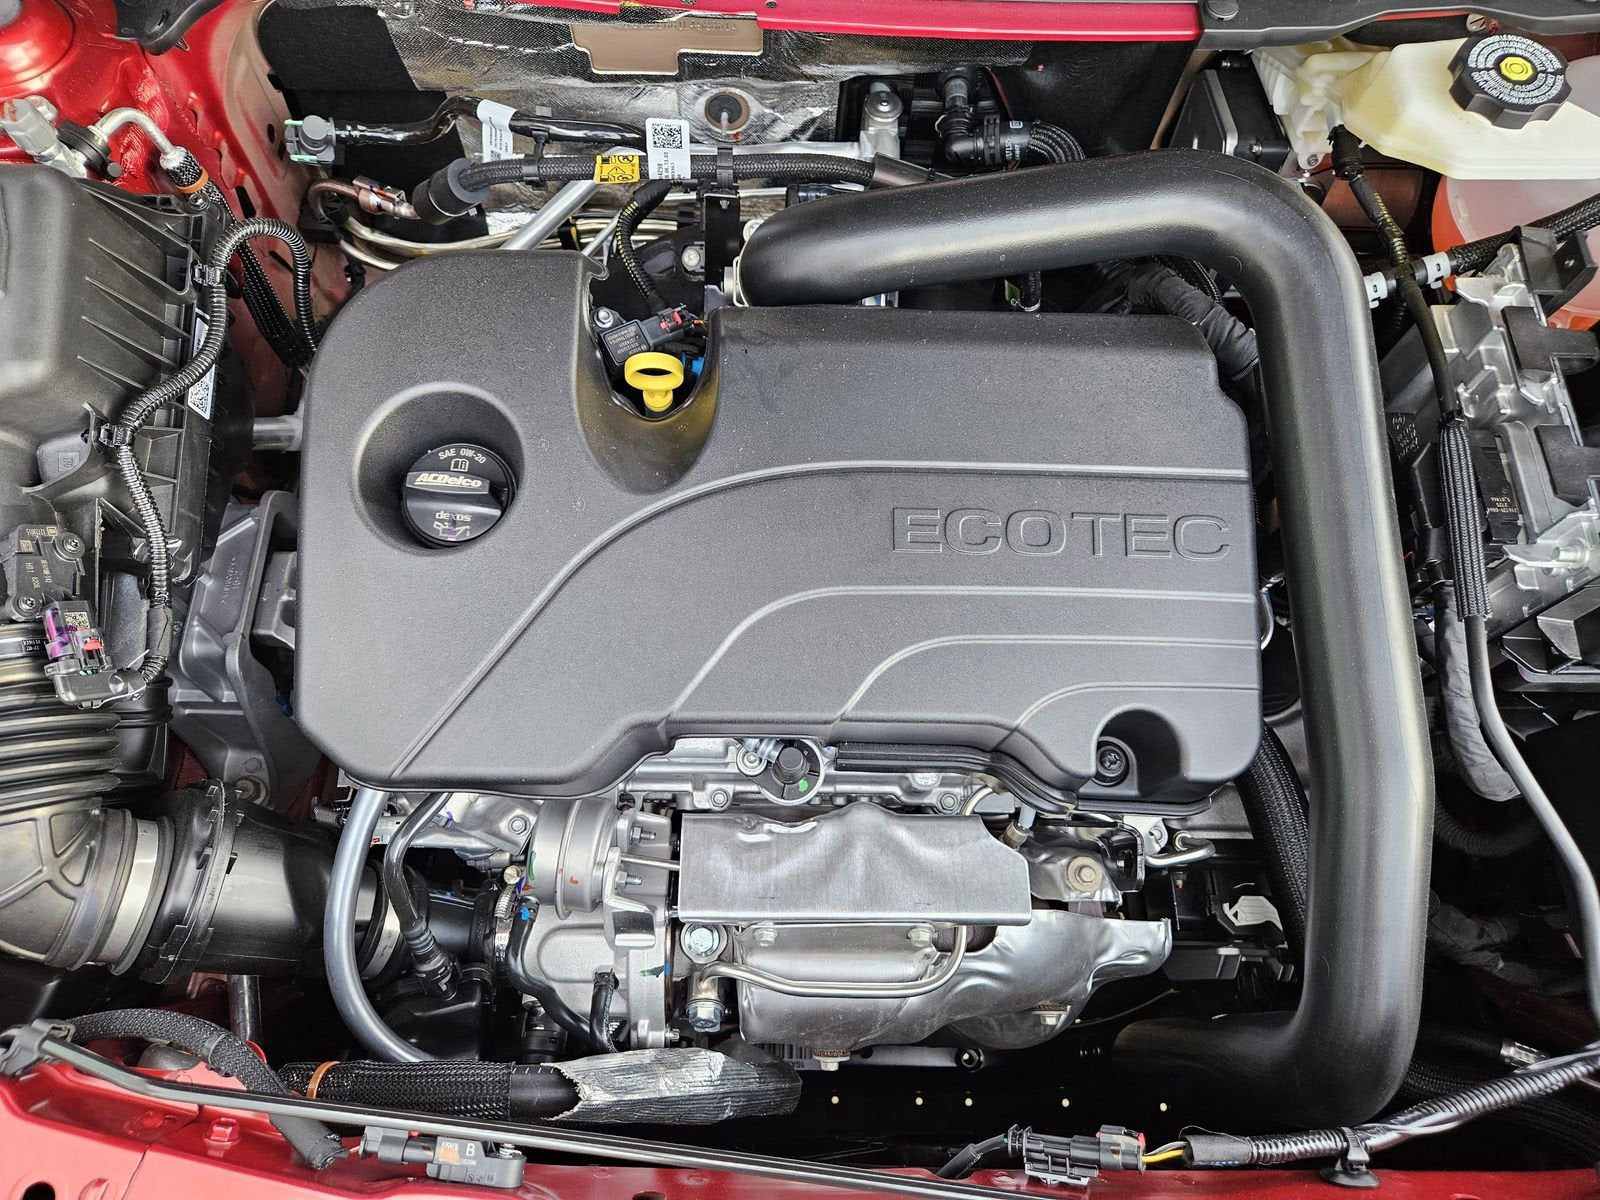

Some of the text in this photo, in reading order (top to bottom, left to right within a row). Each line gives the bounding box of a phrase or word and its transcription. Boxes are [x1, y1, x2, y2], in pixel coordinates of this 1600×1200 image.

[438, 448, 486, 464] SAE 0W-20
[416, 472, 482, 488] ACDelco
[436, 510, 472, 522] dexos
[892, 507, 1230, 562] ECOTEC
[466, 1143, 475, 1156] B
